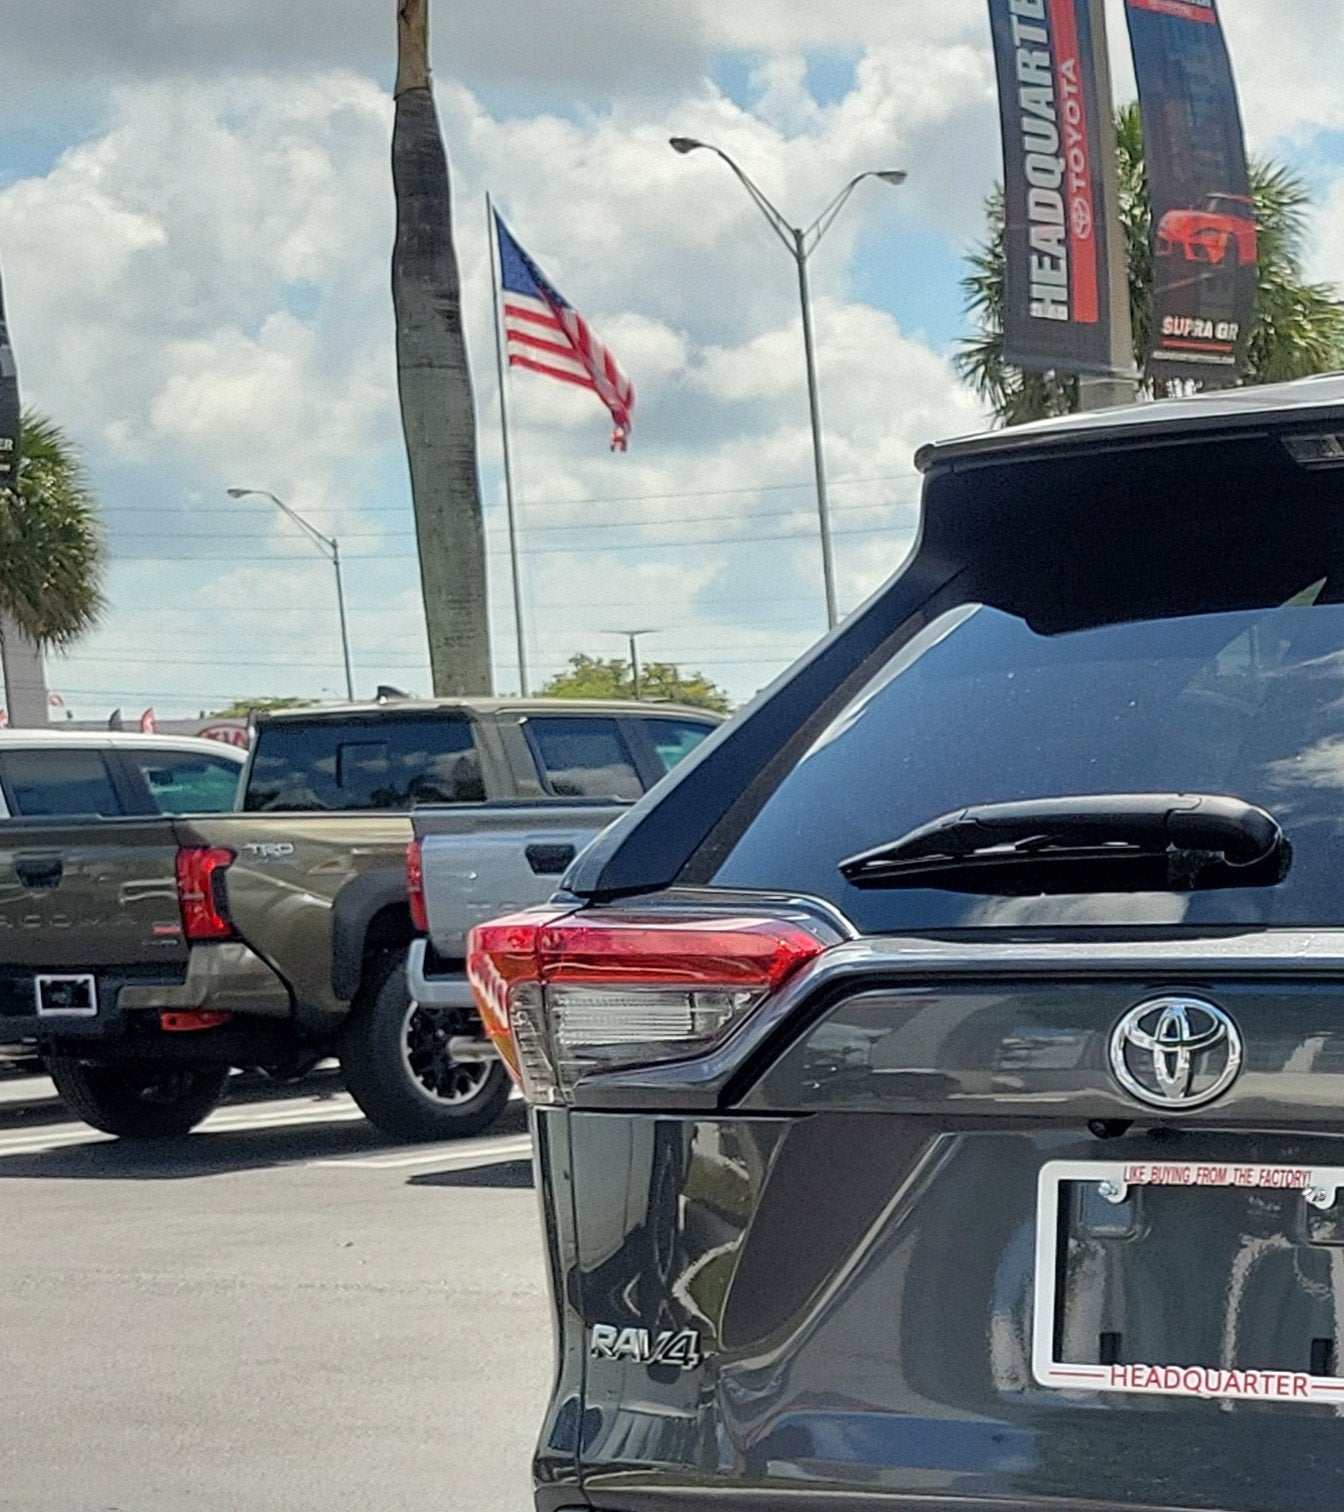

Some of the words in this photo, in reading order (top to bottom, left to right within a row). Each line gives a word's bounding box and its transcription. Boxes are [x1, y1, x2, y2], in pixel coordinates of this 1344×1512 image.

[1061, 58, 1088, 193] TOYOTA
[1162, 315, 1213, 339] SUPRA
[1214, 321, 1240, 341] GR
[1123, 1165, 1146, 1183] LIKE
[1150, 1166, 1191, 1184] BUYING
[1196, 1167, 1227, 1185] FROM
[1232, 1169, 1252, 1185] THE
[1259, 1170, 1313, 1189] FACTORY!
[591, 1323, 700, 1371] RAV4
[1110, 1365, 1309, 1397] HEADQUARTER
